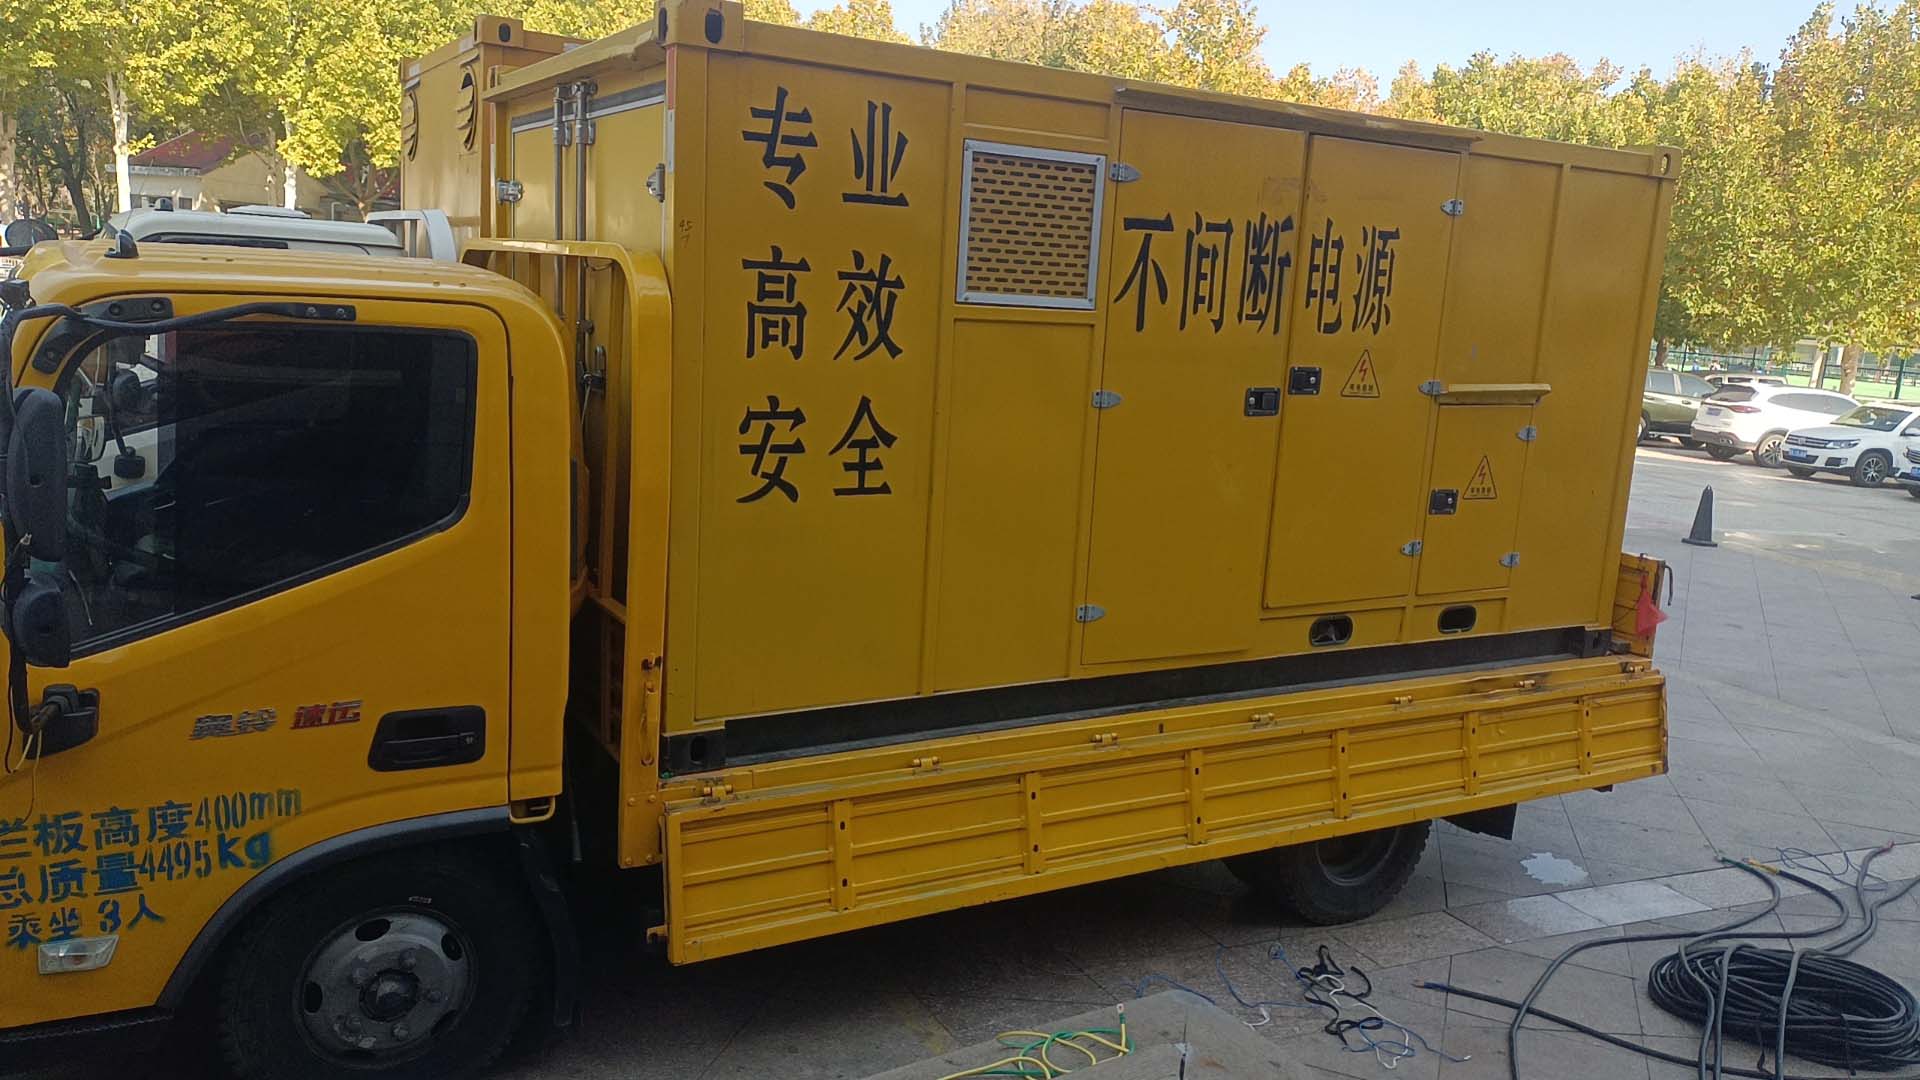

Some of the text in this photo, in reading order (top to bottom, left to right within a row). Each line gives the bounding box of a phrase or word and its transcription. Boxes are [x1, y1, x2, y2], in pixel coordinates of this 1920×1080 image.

[742, 86, 909, 208] 专业
[742, 245, 905, 361] 高效
[1113, 211, 1400, 335] 不间断电源
[736, 395, 898, 503] 安全
